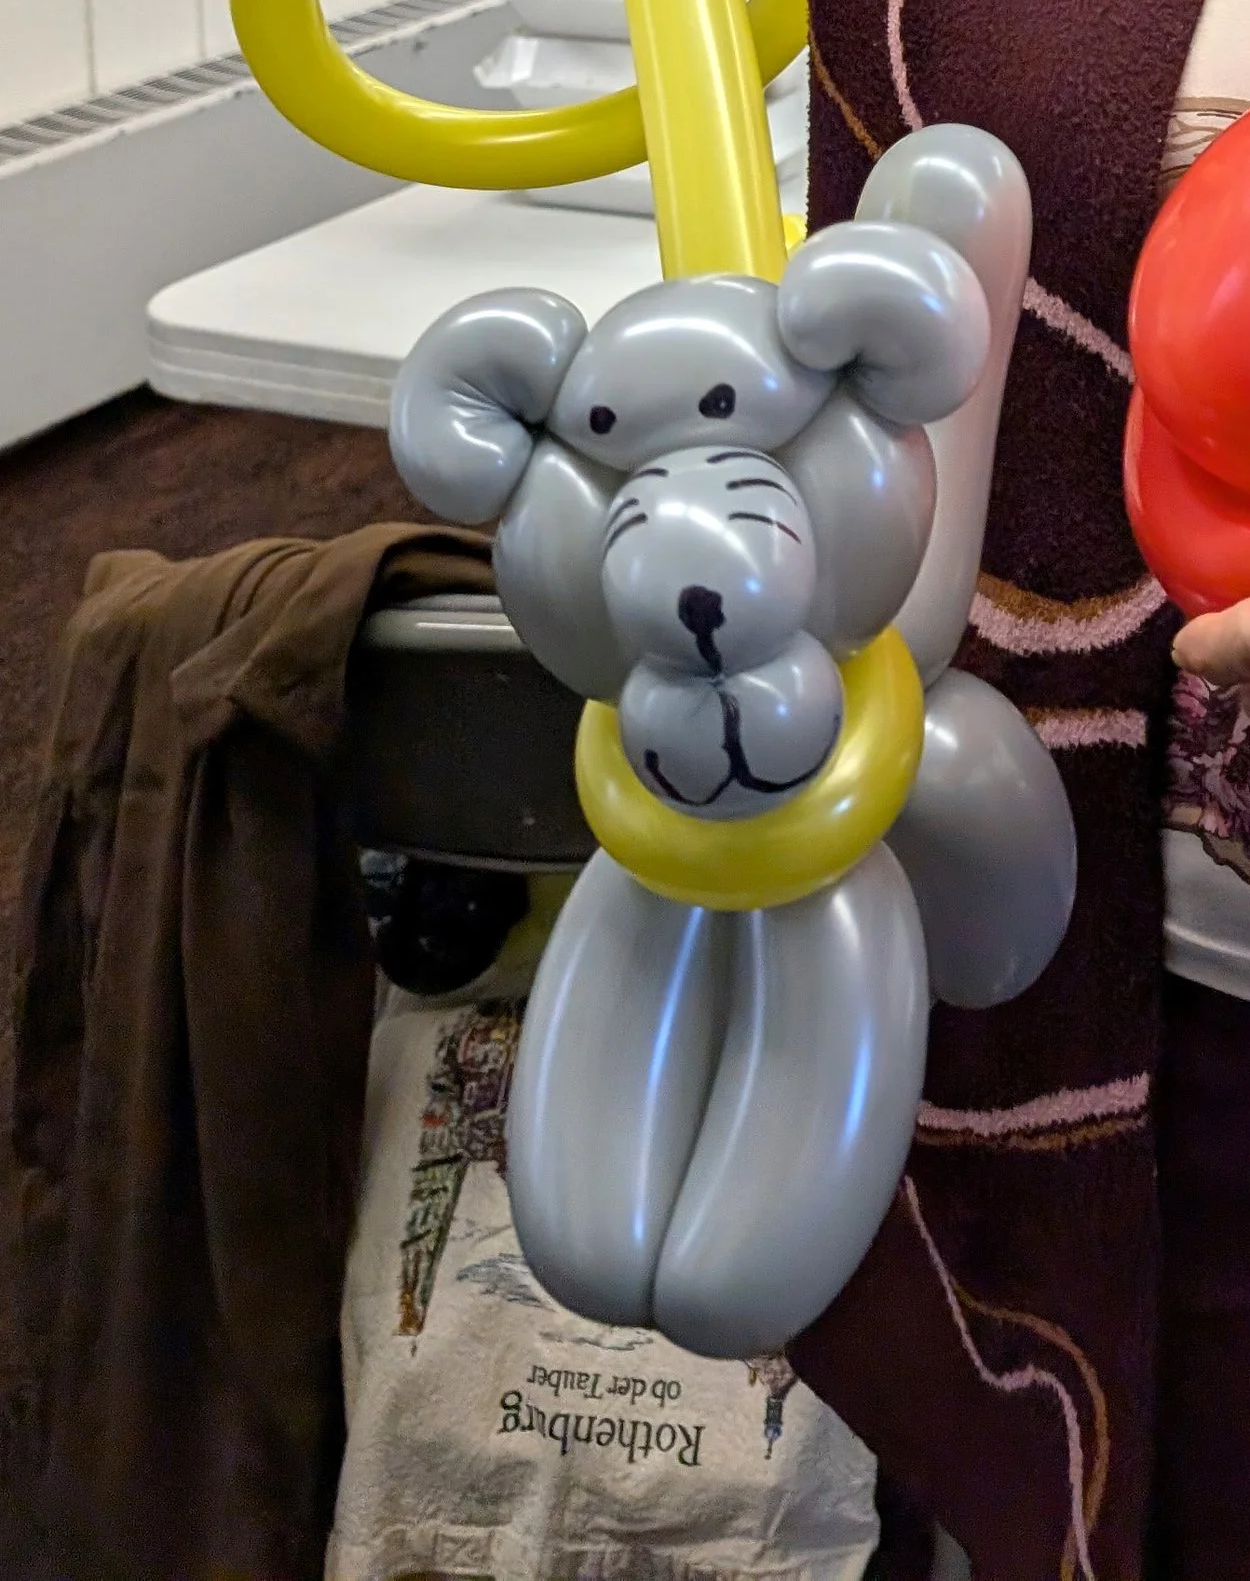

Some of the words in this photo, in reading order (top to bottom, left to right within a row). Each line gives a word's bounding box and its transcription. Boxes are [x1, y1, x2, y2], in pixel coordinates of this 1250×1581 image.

[526, 1365, 603, 1399] Tauber
[606, 1376, 647, 1405] der
[651, 1379, 682, 1408] ob
[498, 1390, 706, 1467] Rothenburg
